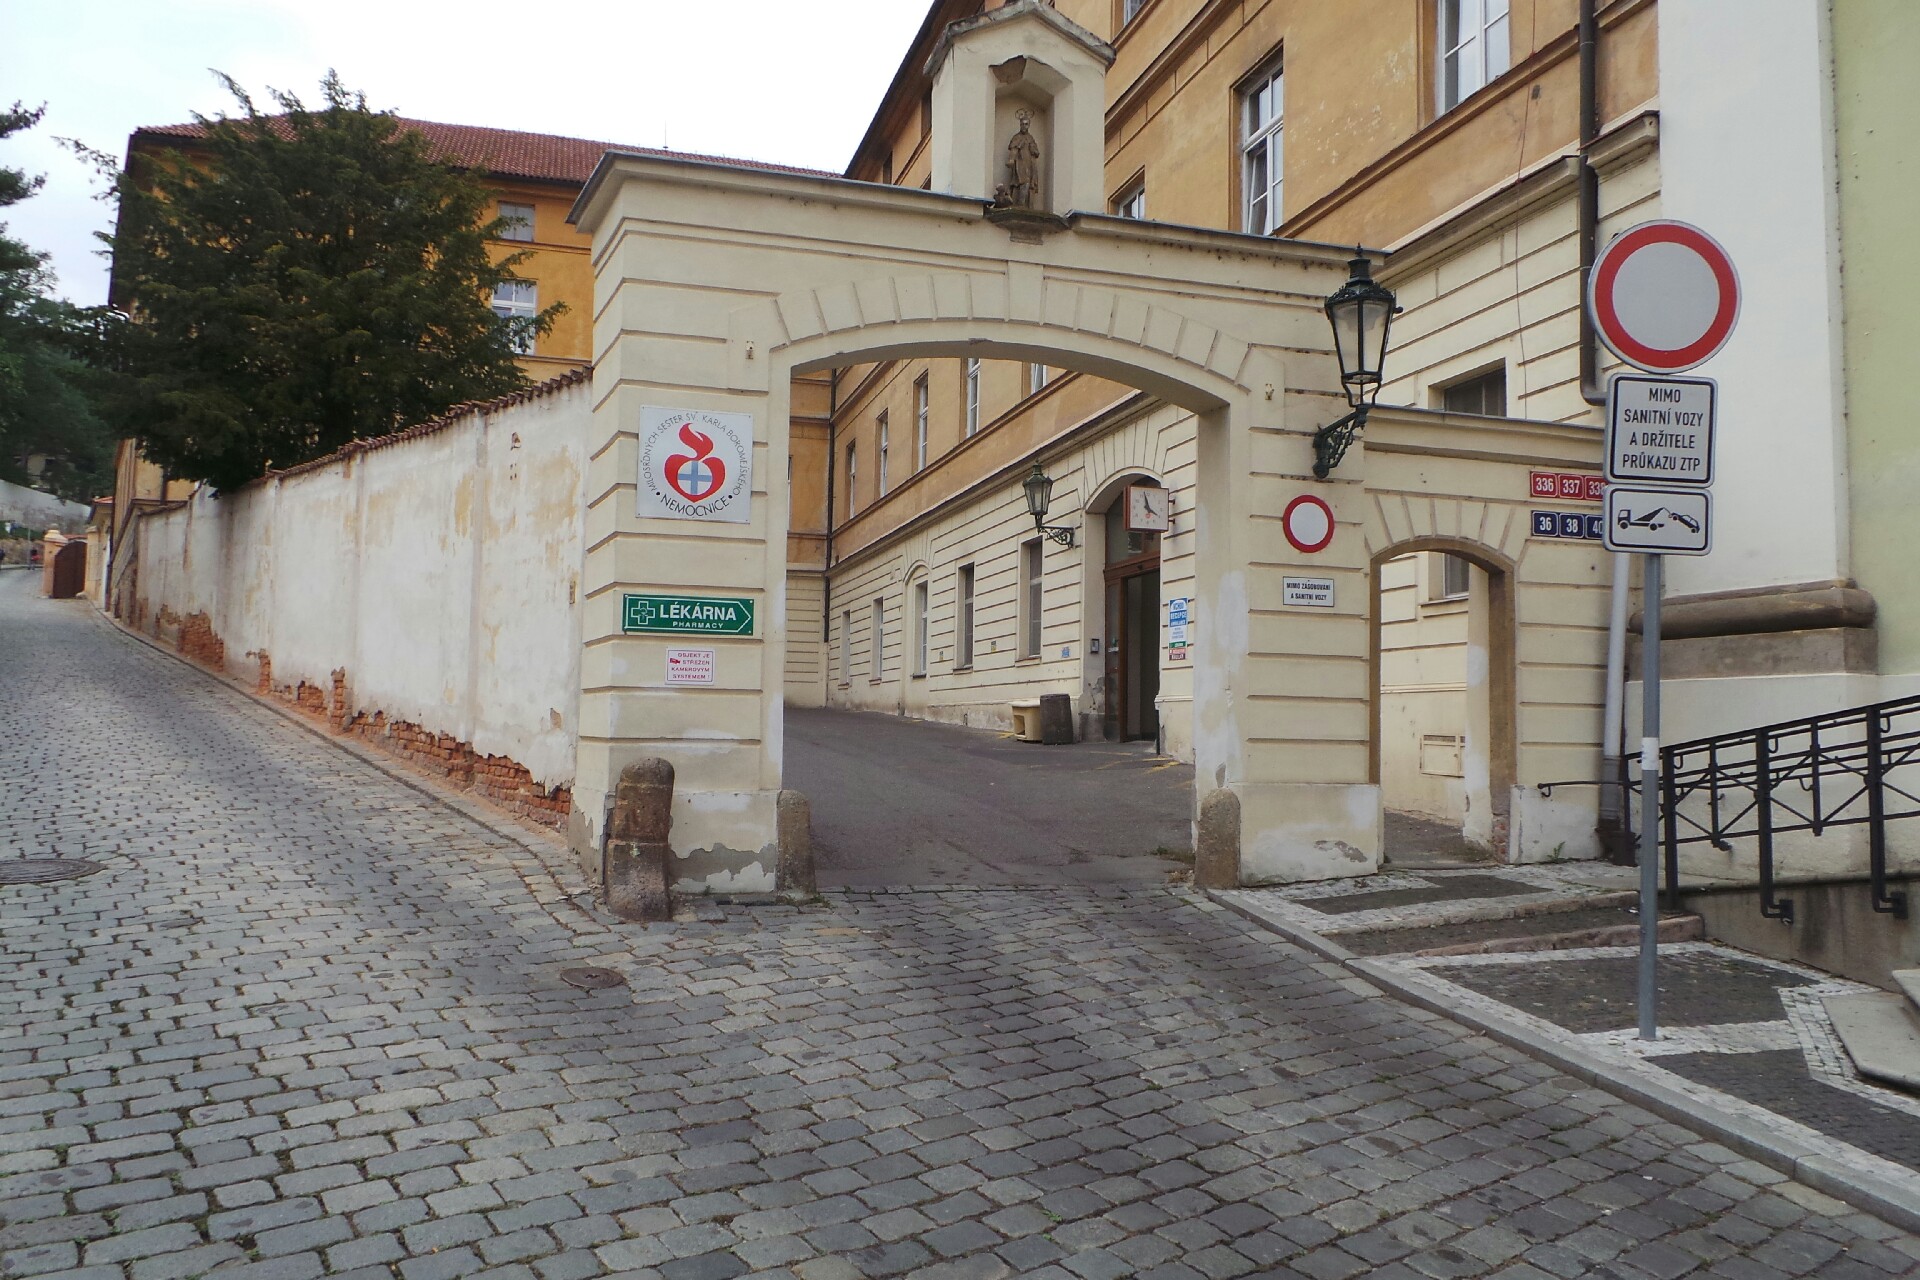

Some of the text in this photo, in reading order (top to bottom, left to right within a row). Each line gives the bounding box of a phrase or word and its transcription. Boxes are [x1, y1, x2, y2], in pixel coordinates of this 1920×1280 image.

[1648, 387, 1681, 403] MIMO
[657, 414, 684, 434] SESTER
[702, 414, 727, 433] KARLA
[1624, 407, 1704, 427] SANITNÍ VOZY
[1629, 429, 1696, 449] A DRŽITELE
[1622, 451, 1701, 472] PRŮKAZU ZTP
[1535, 477, 1554, 492] 336
[1562, 479, 1580, 494] 337
[660, 493, 730, 517] NEMOCNICE
[1539, 516, 1552, 531] 36
[1566, 518, 1578, 533] 38
[659, 601, 737, 621] LÉKÁRNA
[672, 621, 724, 629] PHARMACY
